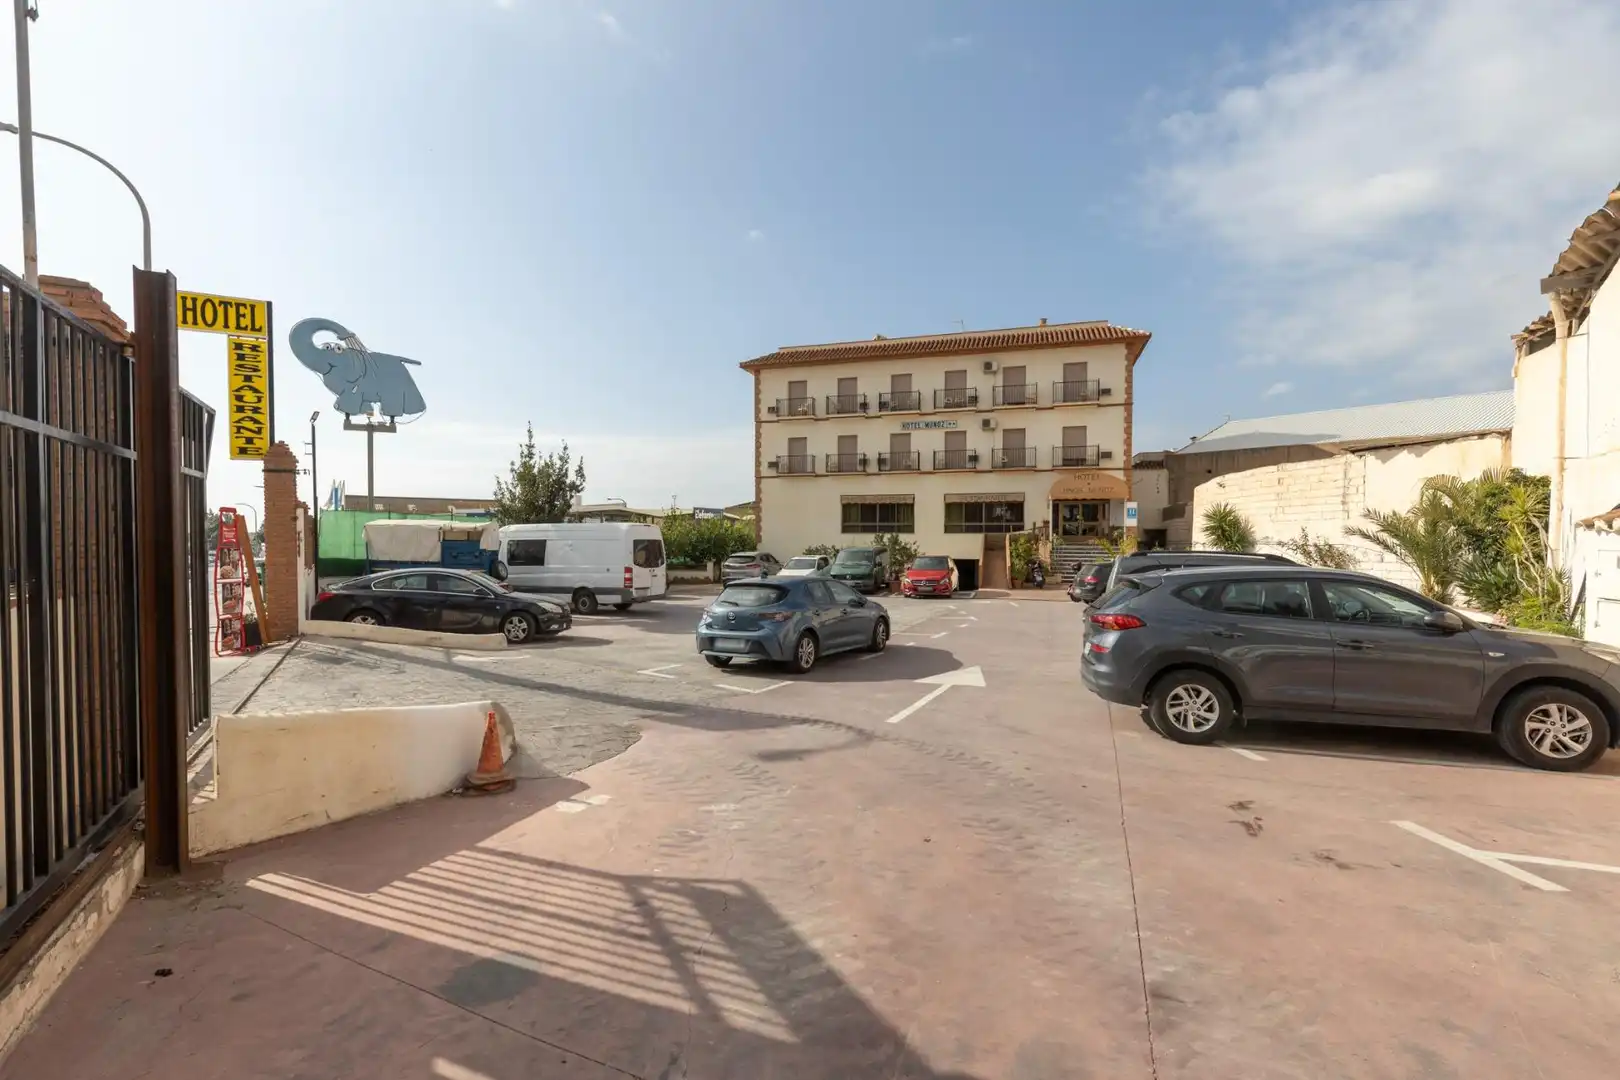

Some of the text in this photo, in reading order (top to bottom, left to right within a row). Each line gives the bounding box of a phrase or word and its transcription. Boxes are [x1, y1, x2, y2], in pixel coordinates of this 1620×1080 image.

[180, 295, 263, 333] HOTEL
[231, 341, 264, 456] RESTAURANTE
[902, 421, 920, 430] HOTEL
[1073, 473, 1101, 481] HOTEL
